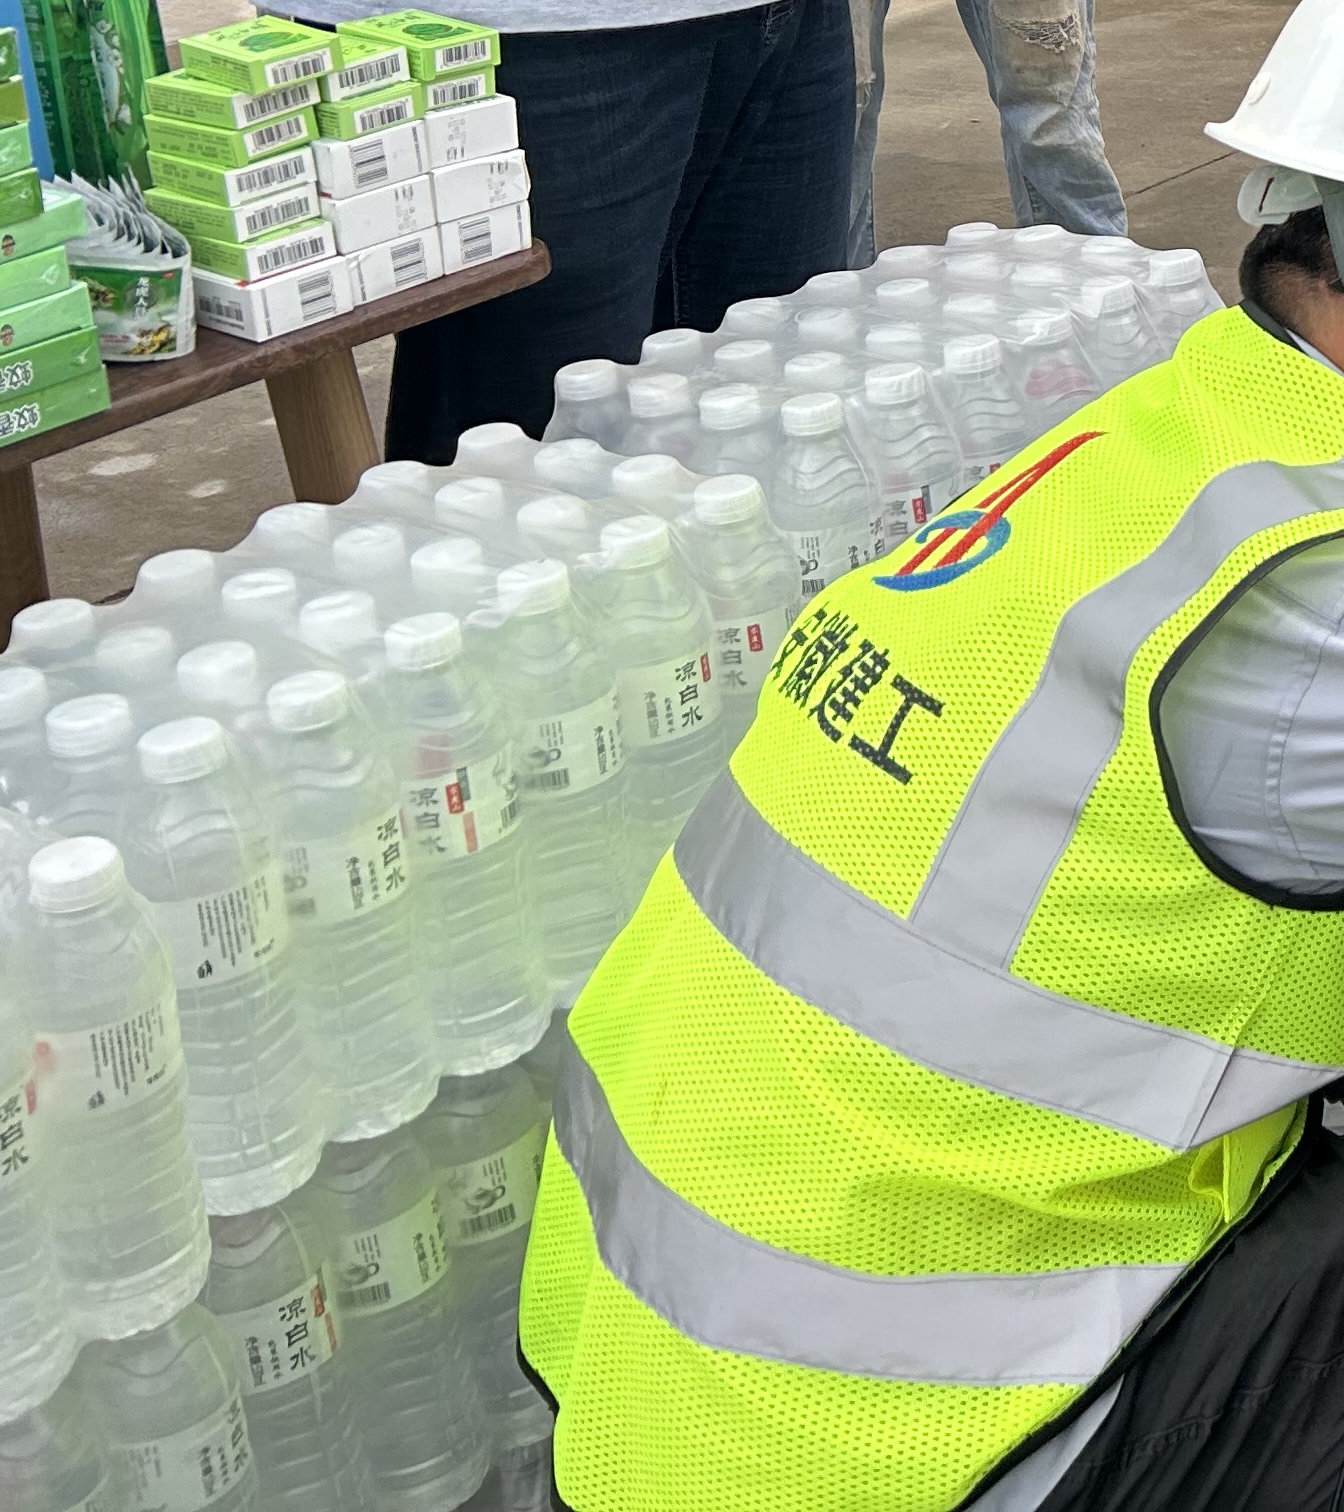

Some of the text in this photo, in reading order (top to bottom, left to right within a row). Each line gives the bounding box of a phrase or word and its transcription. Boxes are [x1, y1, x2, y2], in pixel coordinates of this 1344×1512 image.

[674, 659, 703, 727] 凉白水
[716, 627, 748, 690] 凉白水
[771, 601, 946, 785] 安徽建工
[377, 815, 405, 893] 凉白水
[278, 1295, 317, 1371] 凉白水
